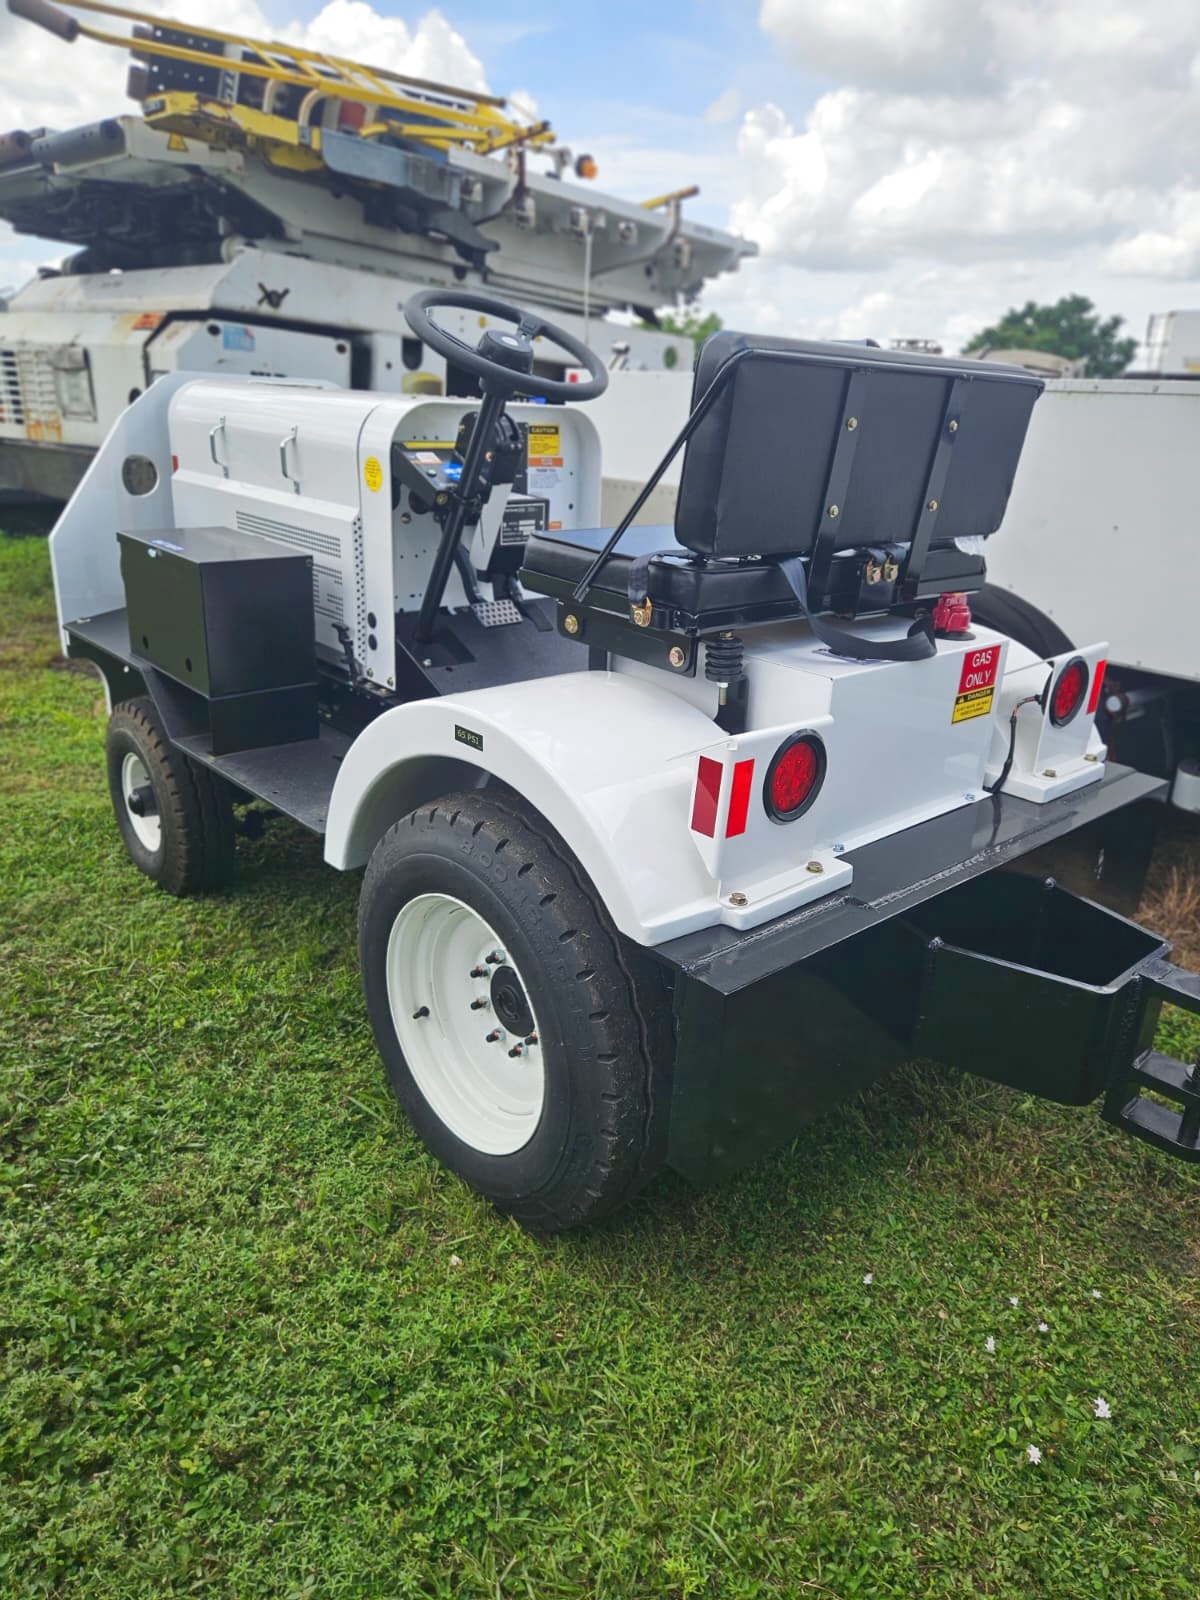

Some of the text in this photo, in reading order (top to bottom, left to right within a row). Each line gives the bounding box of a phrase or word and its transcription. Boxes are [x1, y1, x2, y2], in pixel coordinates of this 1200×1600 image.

[972, 650, 992, 668] GAS
[965, 670, 992, 688] ONLY
[967, 689, 991, 701] DANGER
[467, 733, 479, 745] PSI
